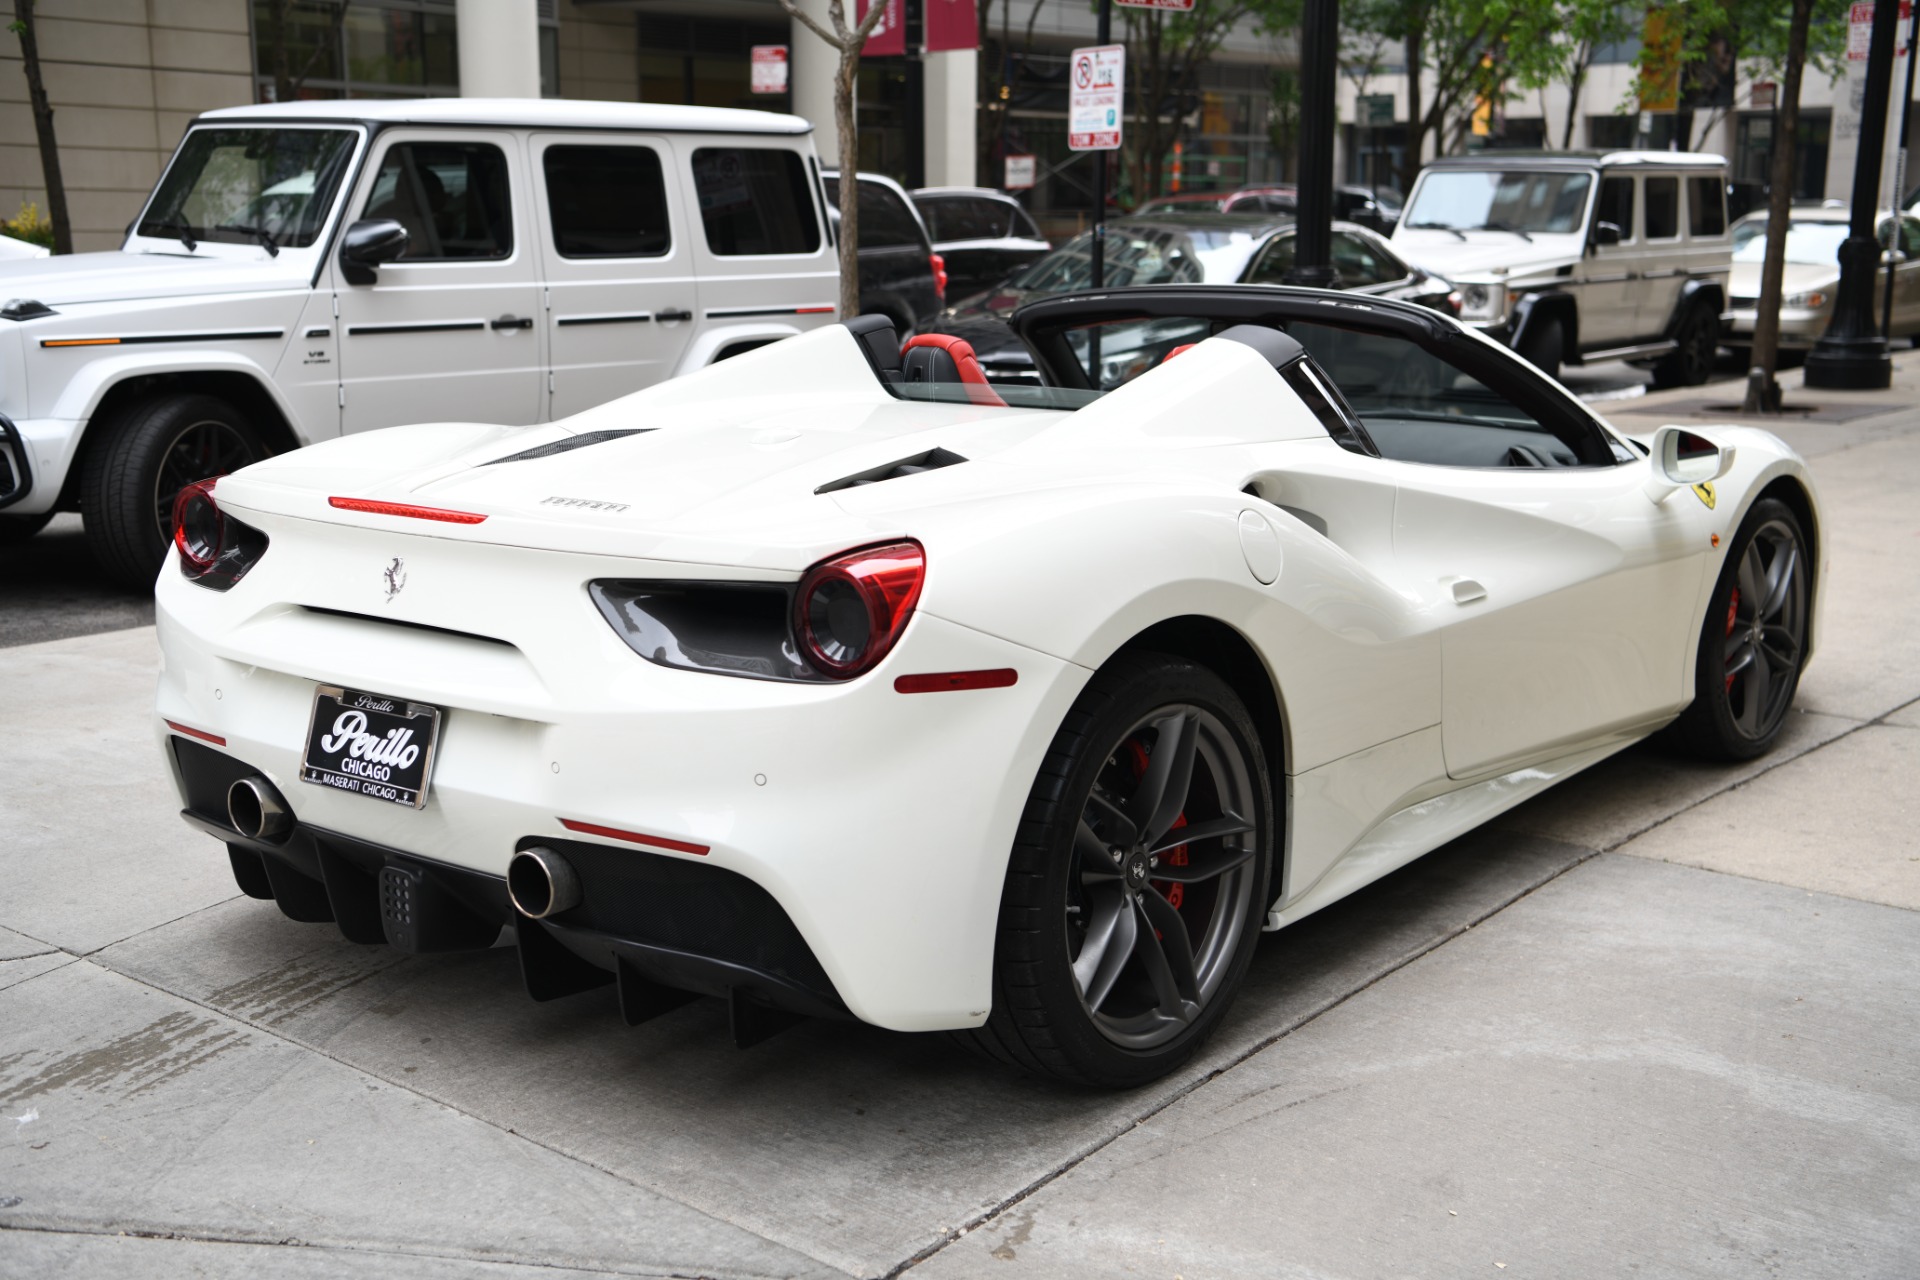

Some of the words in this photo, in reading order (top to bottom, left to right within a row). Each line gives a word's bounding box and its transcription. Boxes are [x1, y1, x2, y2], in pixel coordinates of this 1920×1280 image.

[1093, 131, 1115, 146] ZONE
[354, 695, 394, 712] Perillo
[321, 710, 419, 770] Perillo
[341, 758, 390, 781] CHICAGO
[322, 773, 360, 792] MASERATI
[362, 782, 396, 800] CHICAGO
